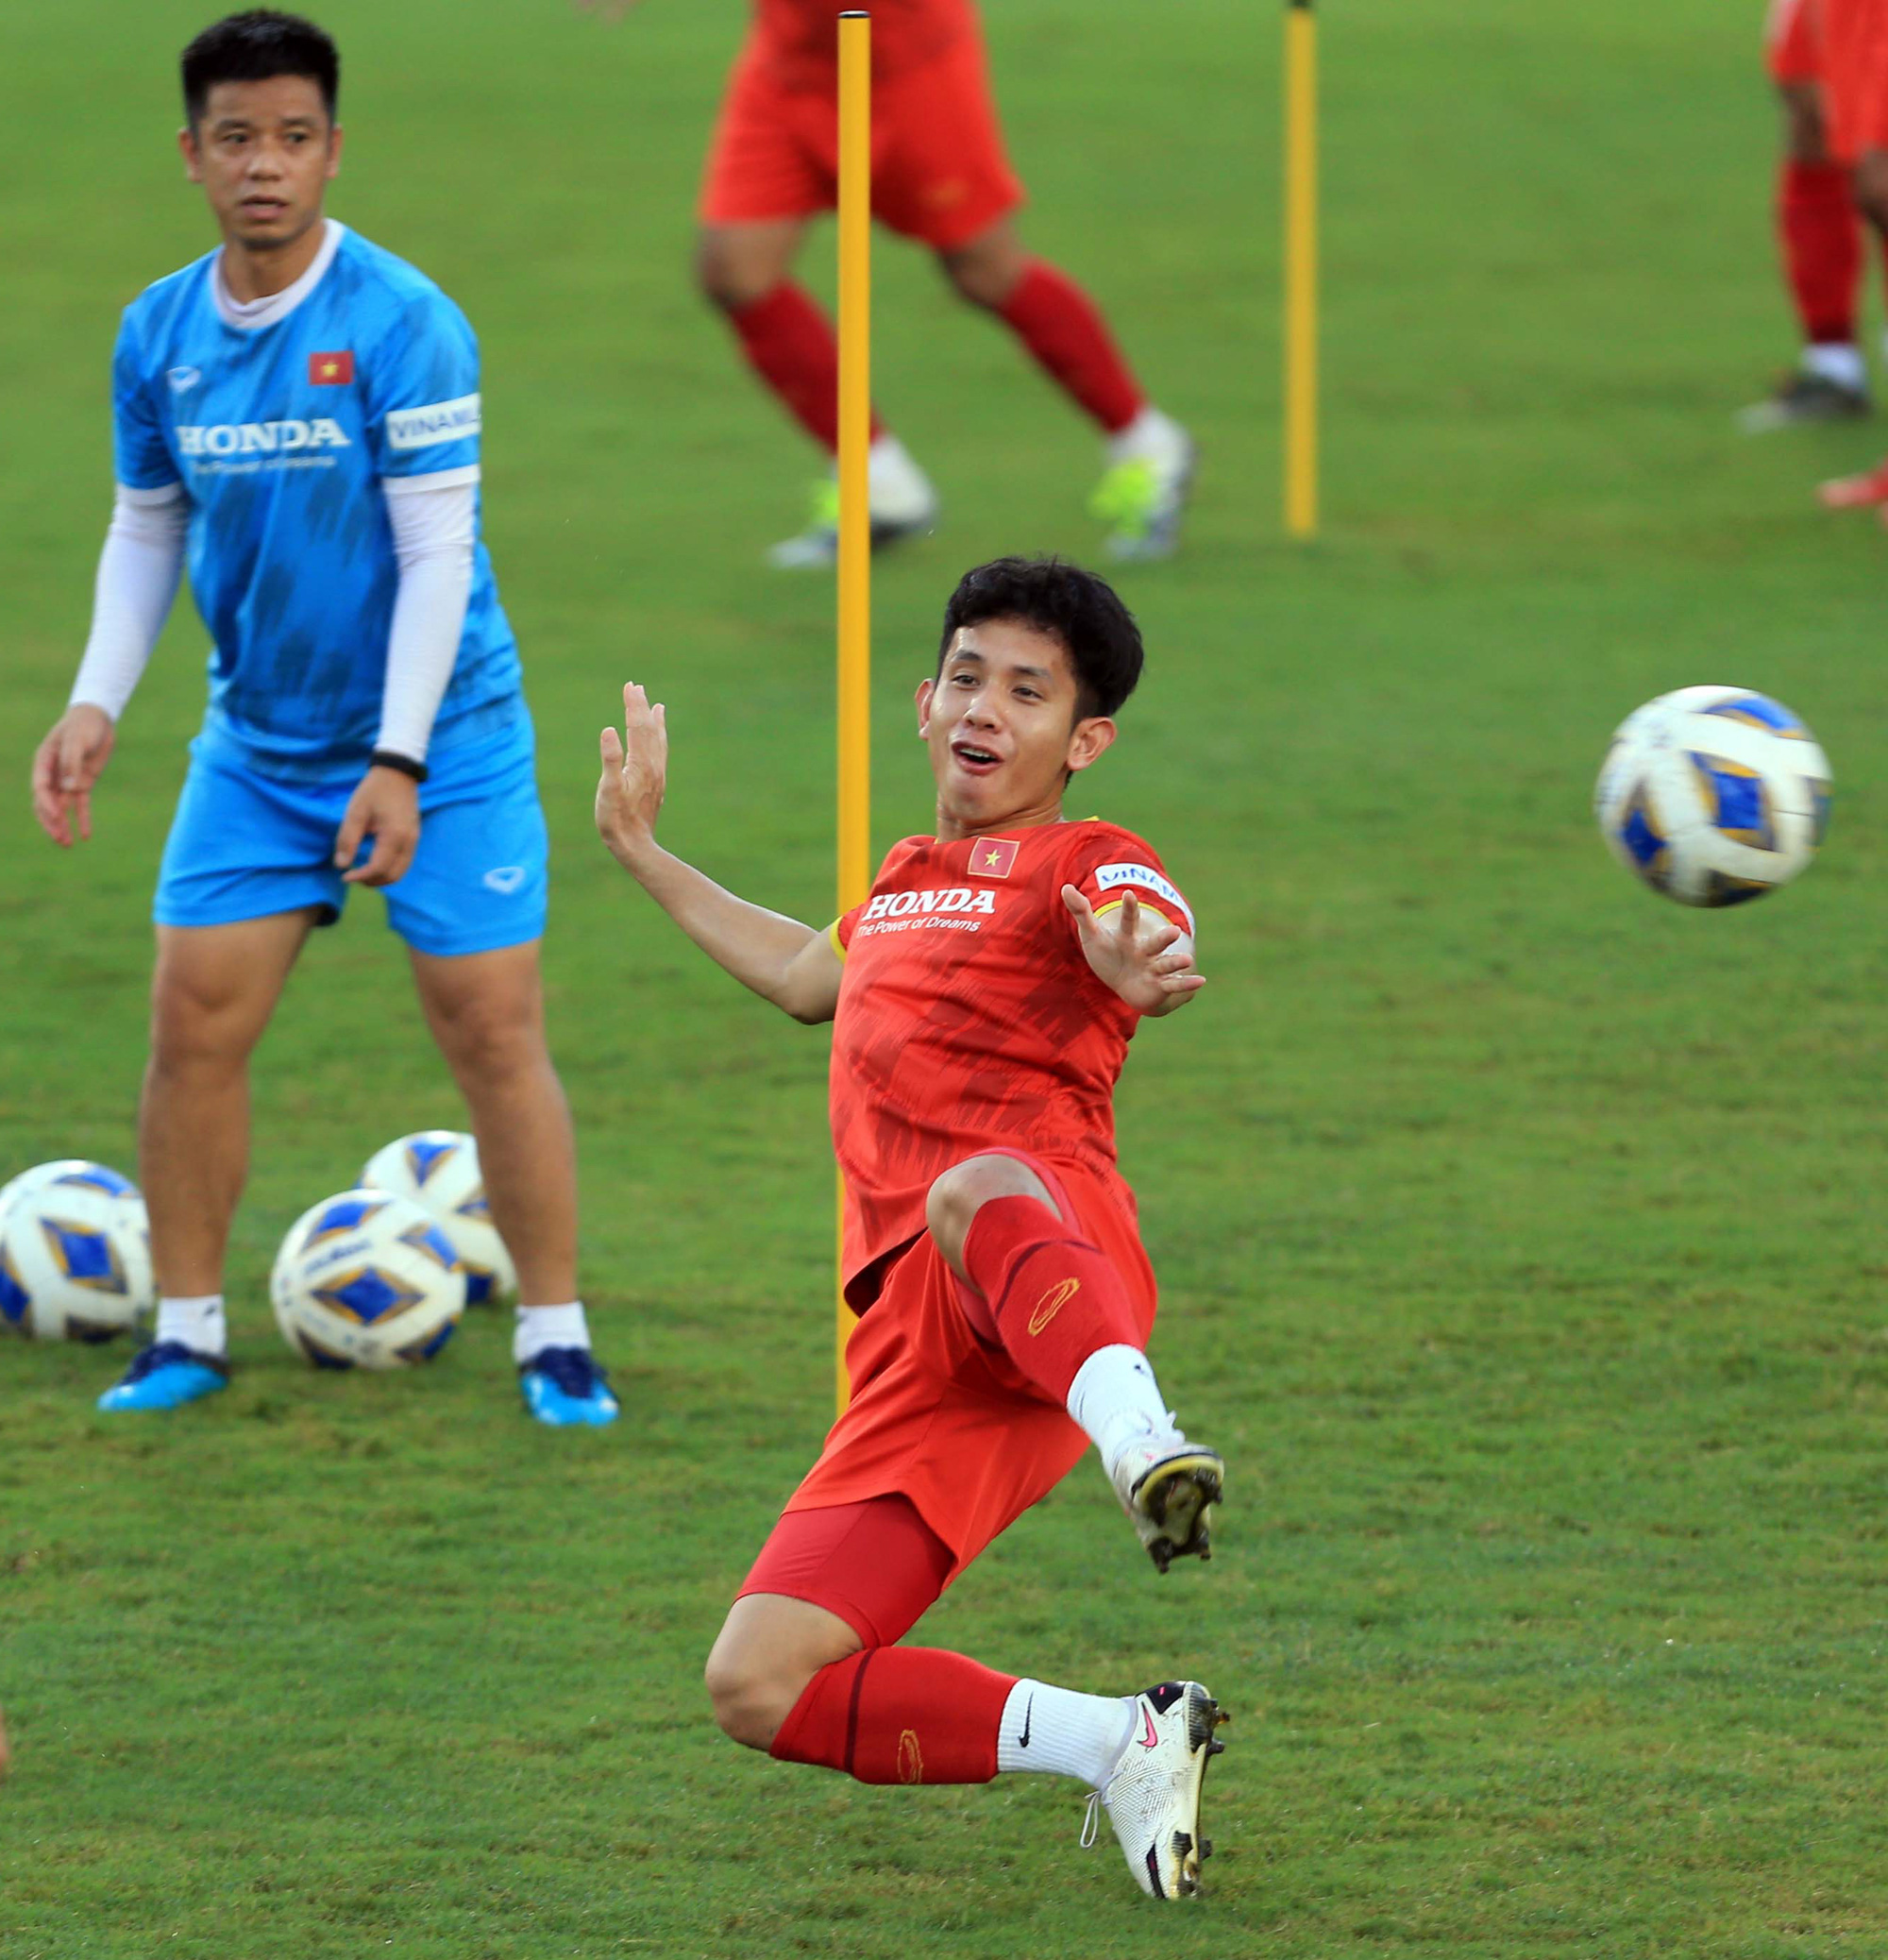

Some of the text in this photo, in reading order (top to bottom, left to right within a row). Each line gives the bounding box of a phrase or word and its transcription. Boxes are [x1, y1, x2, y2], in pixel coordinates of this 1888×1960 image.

[176, 418, 351, 454] HONDA
[1102, 868, 1182, 904] VINAM
[861, 888, 996, 921] HONDA
[857, 917, 981, 938] The Power of Dreams
